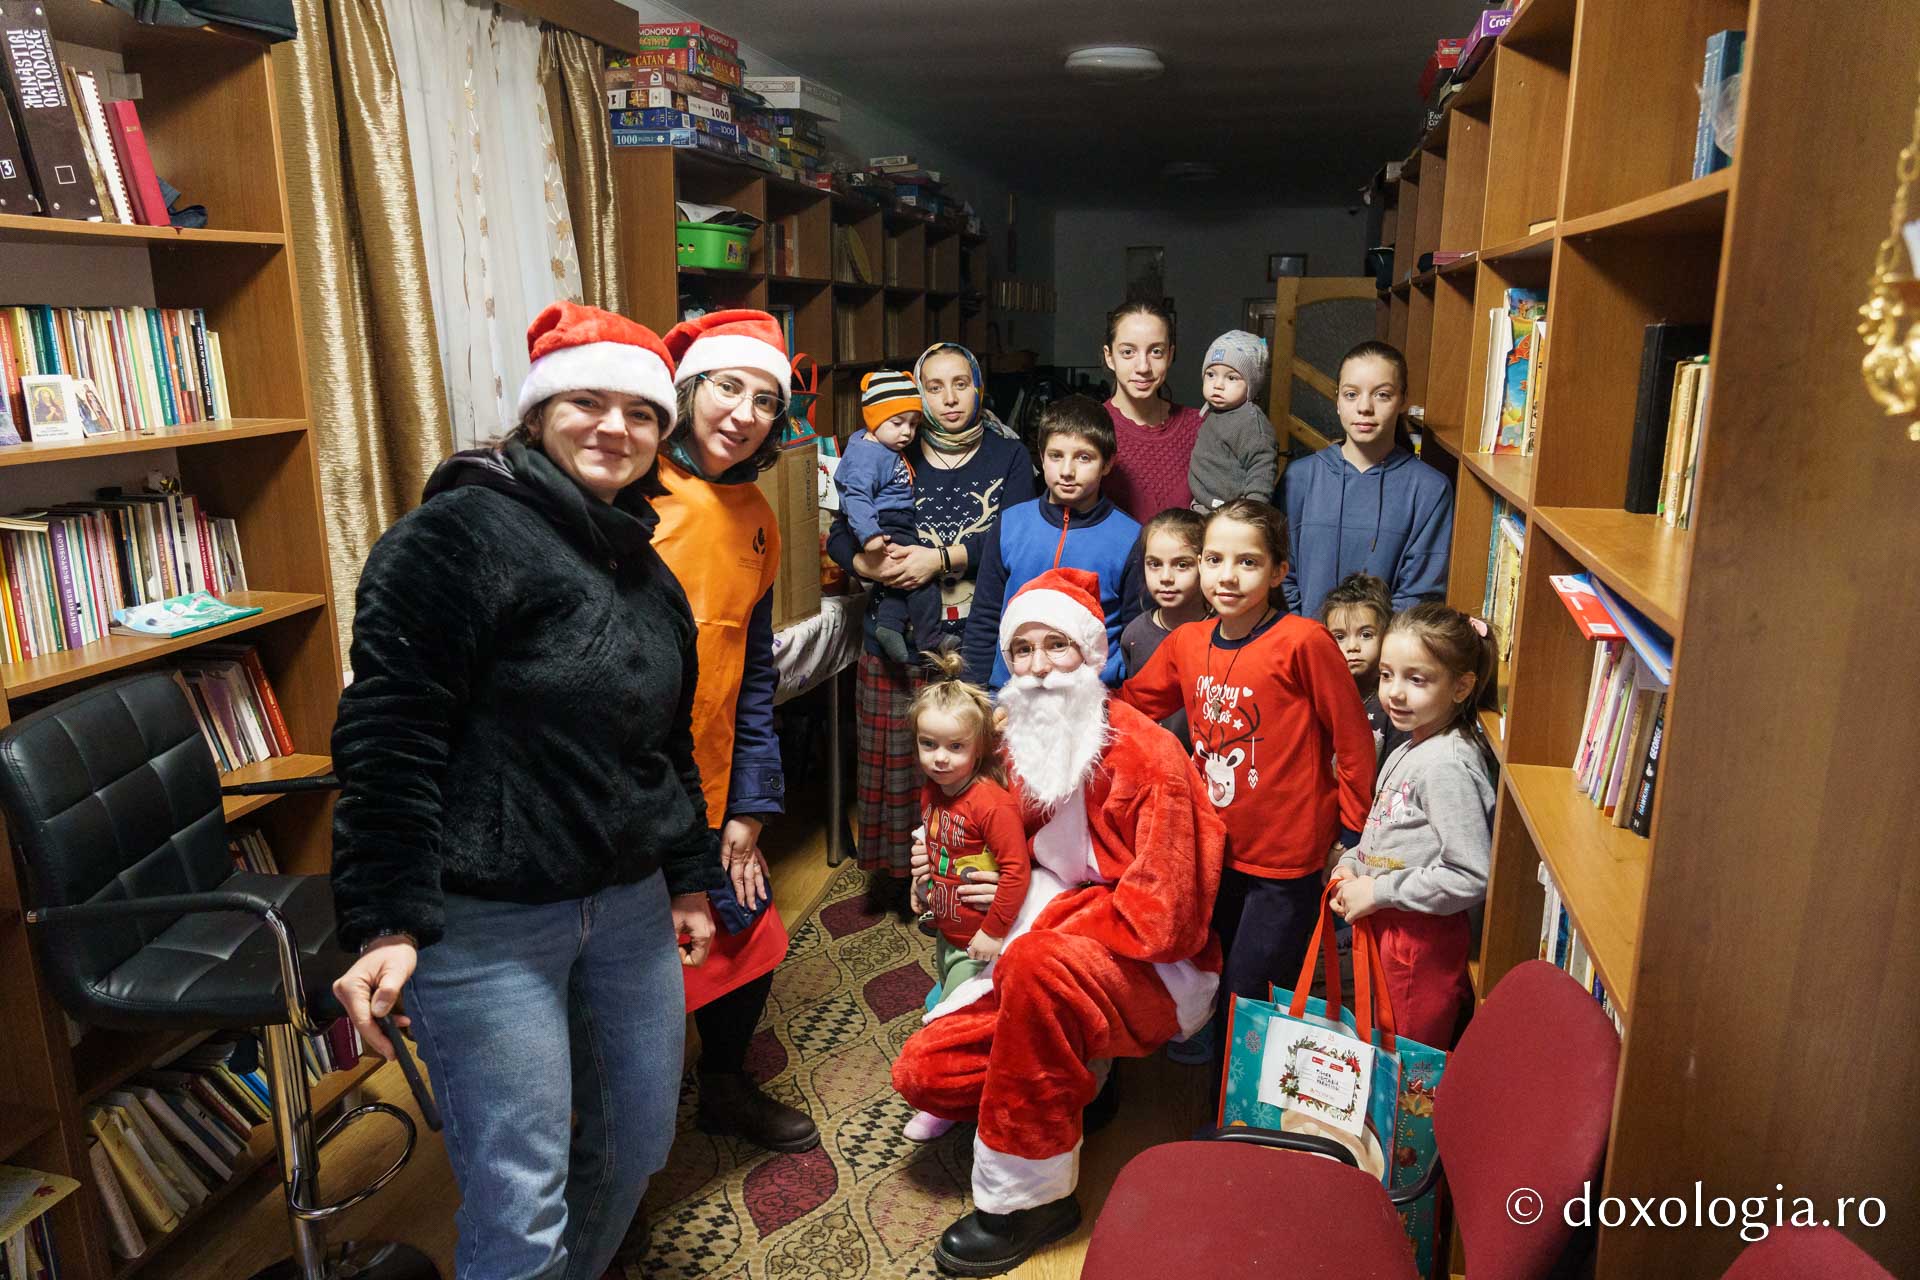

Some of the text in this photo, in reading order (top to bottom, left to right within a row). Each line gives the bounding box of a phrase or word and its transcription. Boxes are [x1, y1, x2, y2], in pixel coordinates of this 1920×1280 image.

[635, 54, 665, 66] CATAN
[6, 29, 44, 109] MĂNĂSTIRI
[24, 29, 61, 108] ORTODOXE
[711, 107, 730, 121] 1000
[720, 126, 735, 136] 1000
[616, 135, 638, 145] 1000
[3, 161, 13, 176] 3
[1196, 675, 1240, 709] Merry
[1649, 726, 1662, 760] GEORGE
